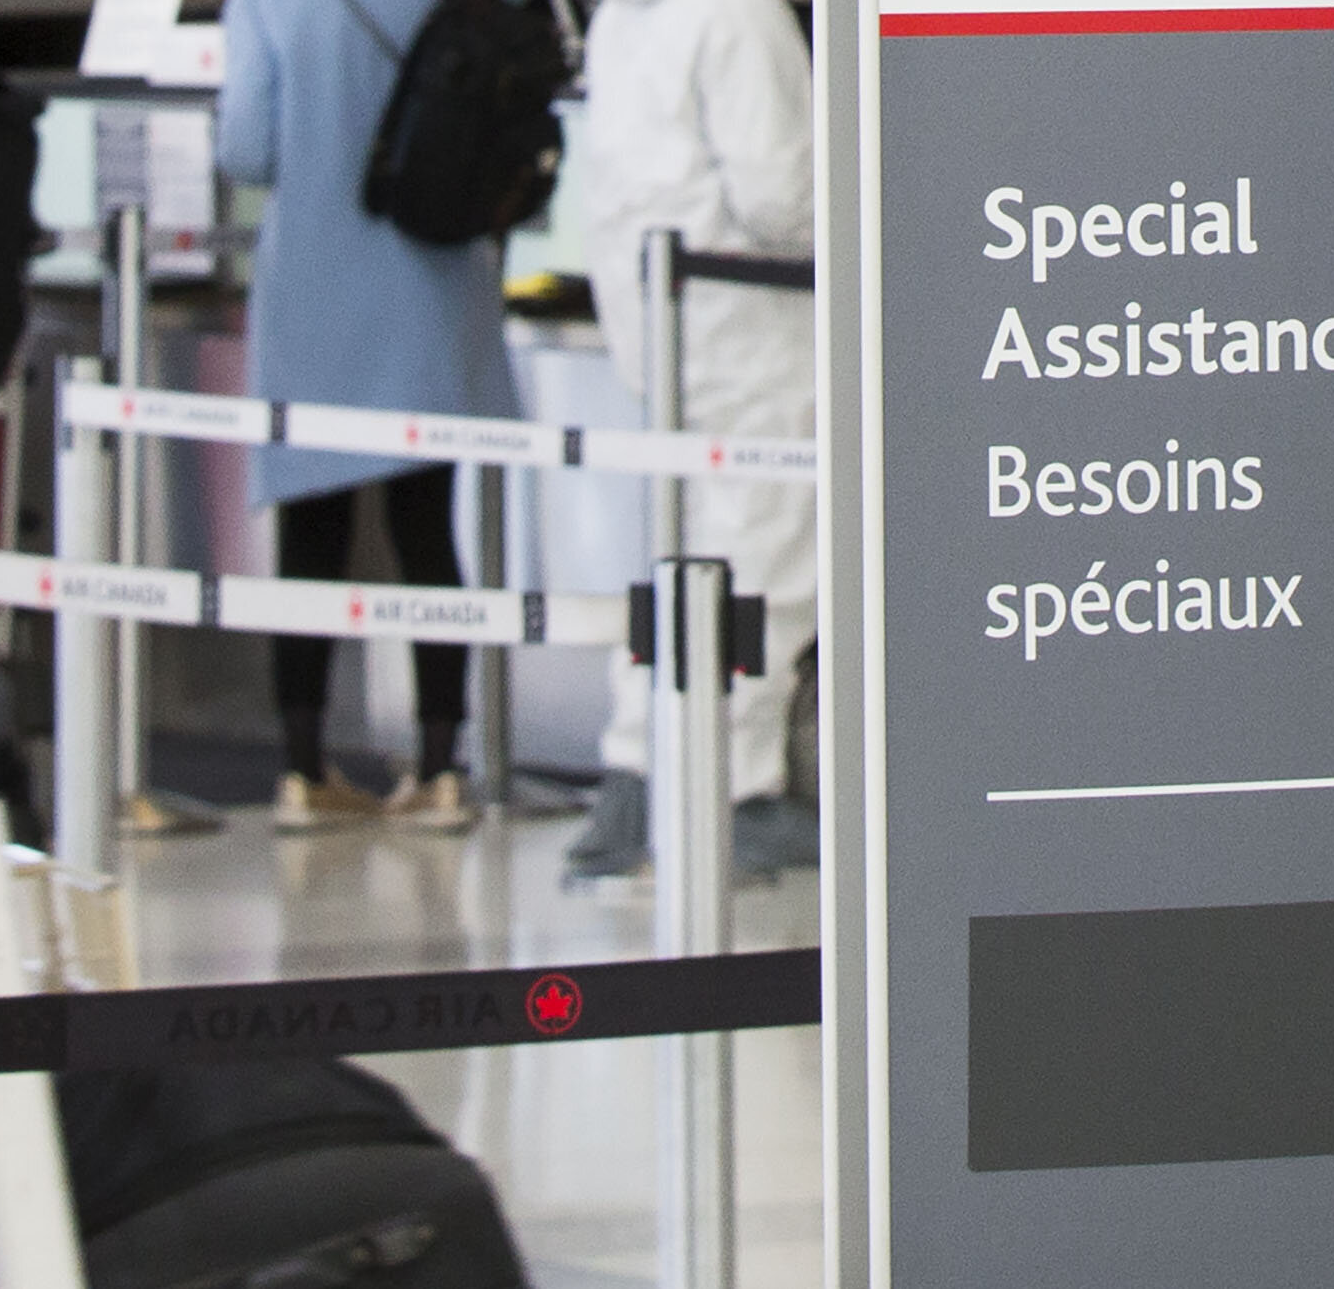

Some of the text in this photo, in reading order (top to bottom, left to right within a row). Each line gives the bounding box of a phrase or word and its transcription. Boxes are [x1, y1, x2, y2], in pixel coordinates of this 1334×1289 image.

[982, 177, 1259, 283] Special
[987, 438, 1264, 518] Besoins
[984, 558, 1304, 661] spéciaux
